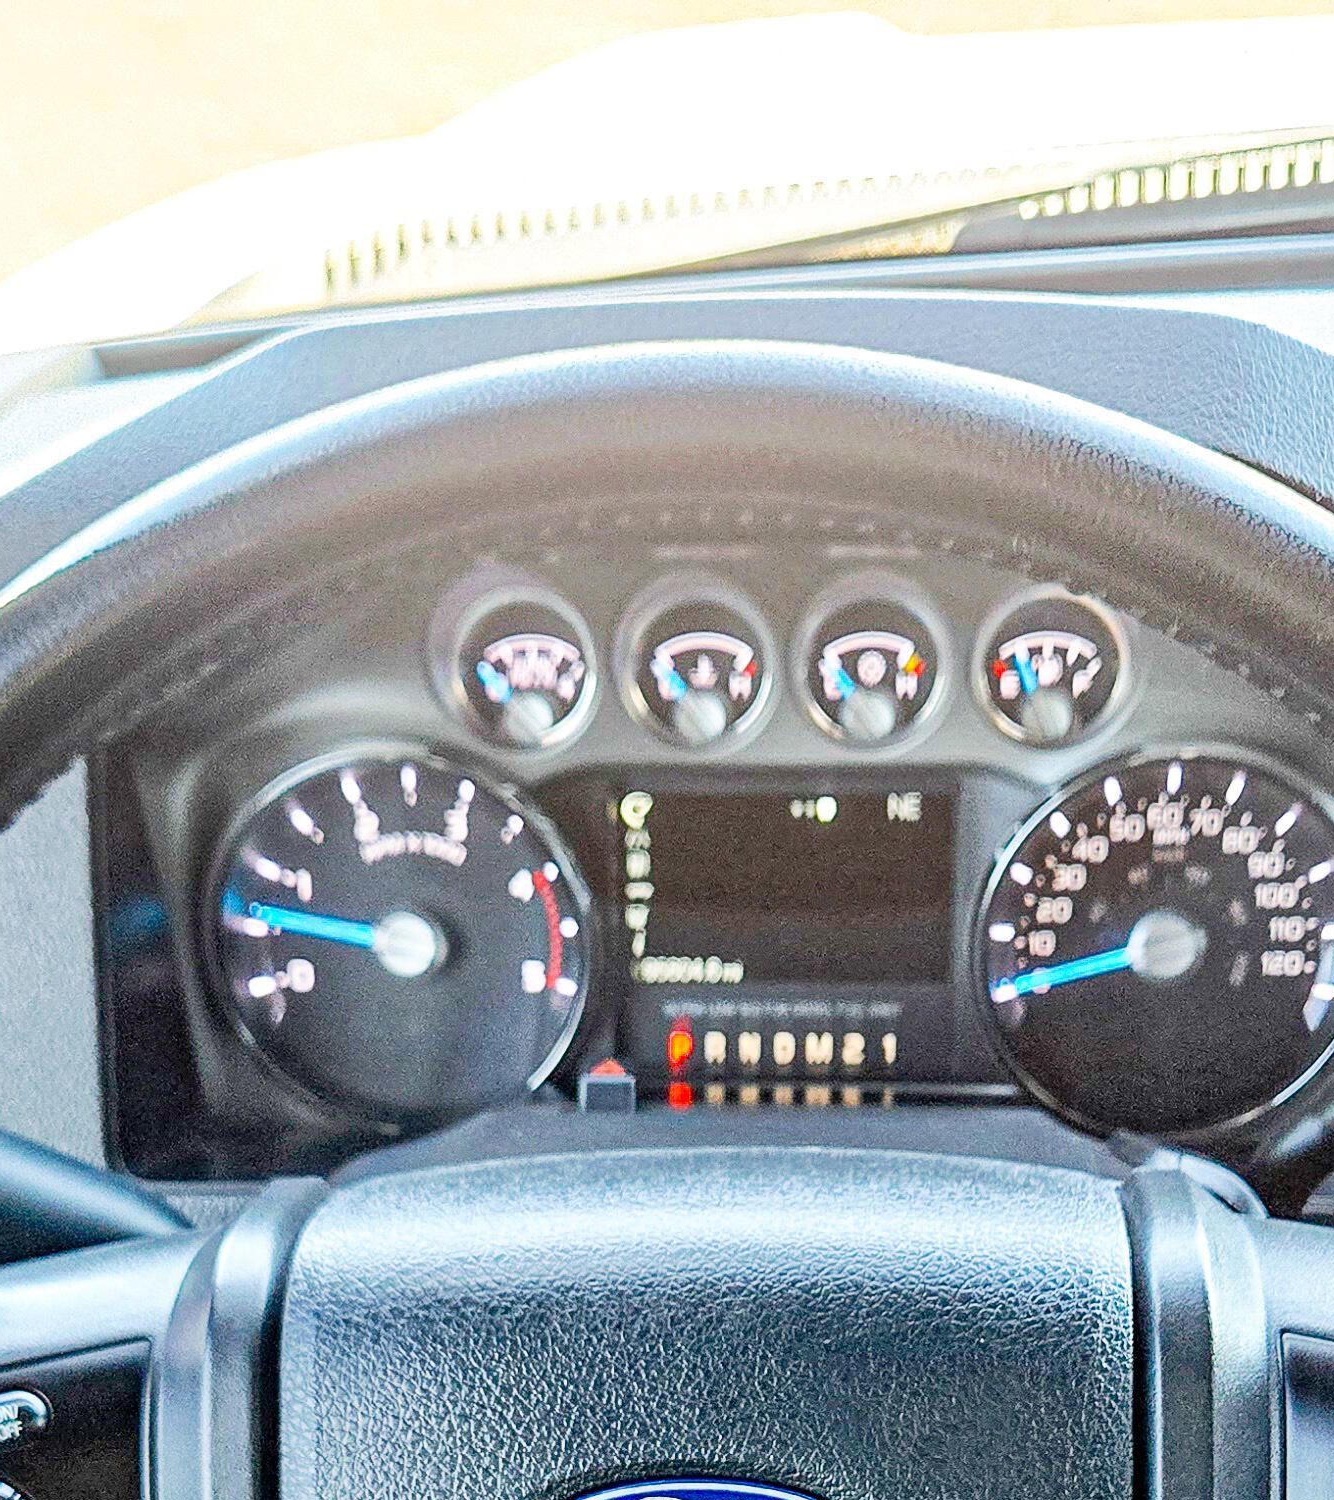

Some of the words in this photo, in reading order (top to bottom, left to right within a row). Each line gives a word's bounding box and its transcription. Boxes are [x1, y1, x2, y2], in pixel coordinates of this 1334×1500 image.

[1189, 808, 1224, 836] 70
[1072, 835, 1109, 863] 40
[1254, 882, 1299, 909] 100
[1036, 896, 1073, 924] 20
[1270, 916, 1306, 942] 110
